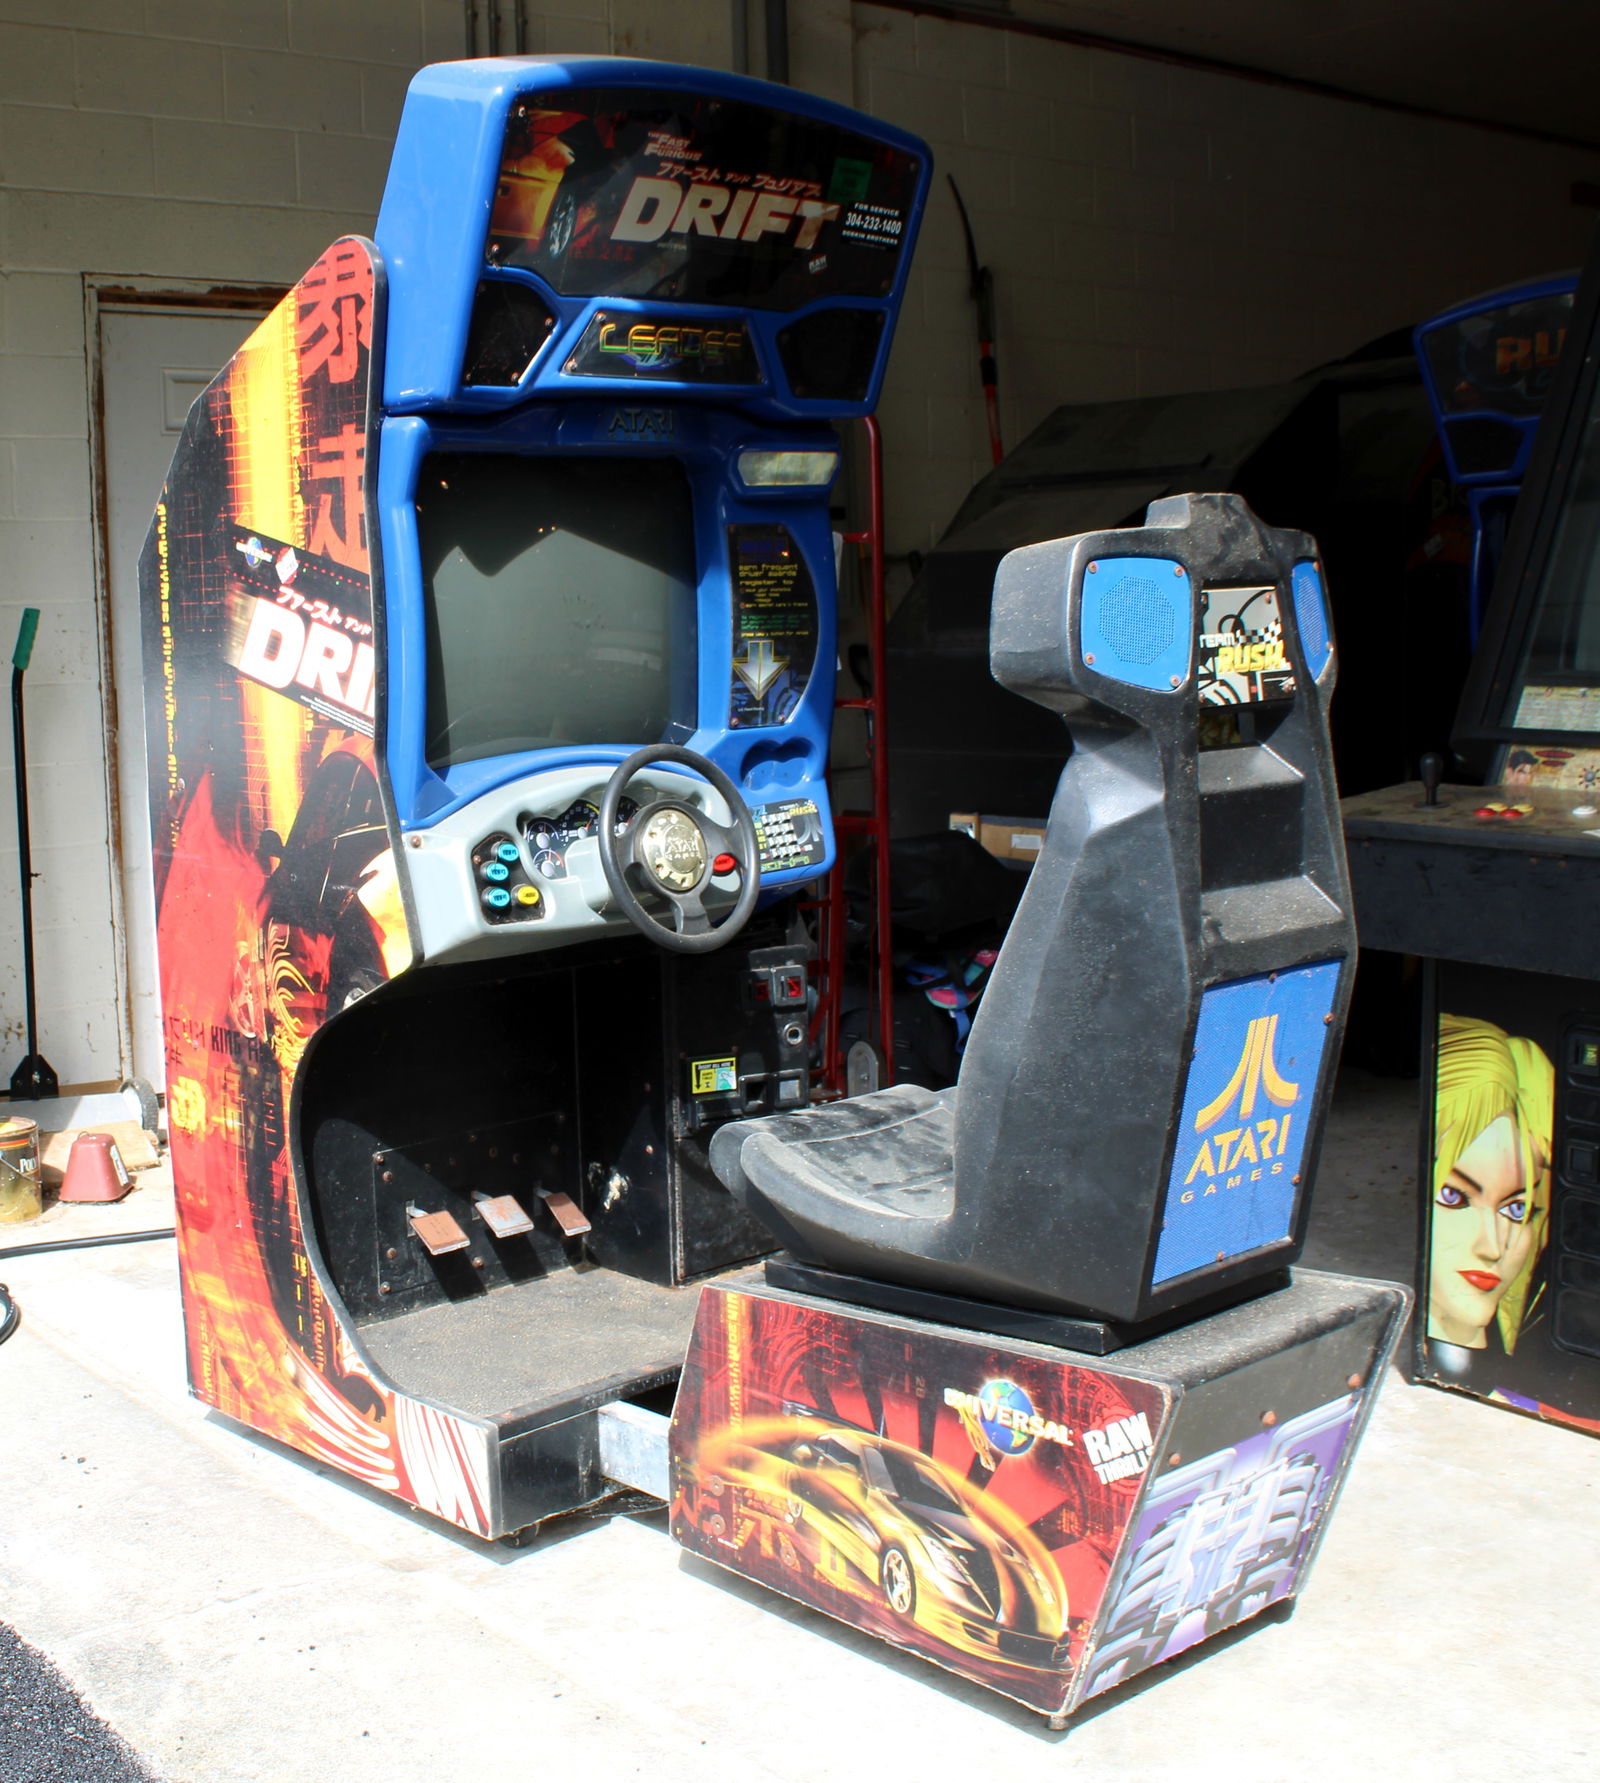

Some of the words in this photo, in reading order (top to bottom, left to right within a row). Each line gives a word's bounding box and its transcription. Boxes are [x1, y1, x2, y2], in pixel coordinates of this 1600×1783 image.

[609, 175, 841, 251] DRIFT
[845, 212, 902, 235] 304-232-1400
[854, 202, 870, 212] FOR
[869, 204, 901, 217] SERVICE
[608, 407, 674, 433] ATARI
[237, 597, 375, 719] DRI
[1217, 639, 1285, 674] RUSH
[1183, 1113, 1293, 1185] ATARI
[1180, 1162, 1284, 1204] GAMES
[944, 1387, 1074, 1447] UNIVERSAL
[1082, 1411, 1153, 1466] RAW
